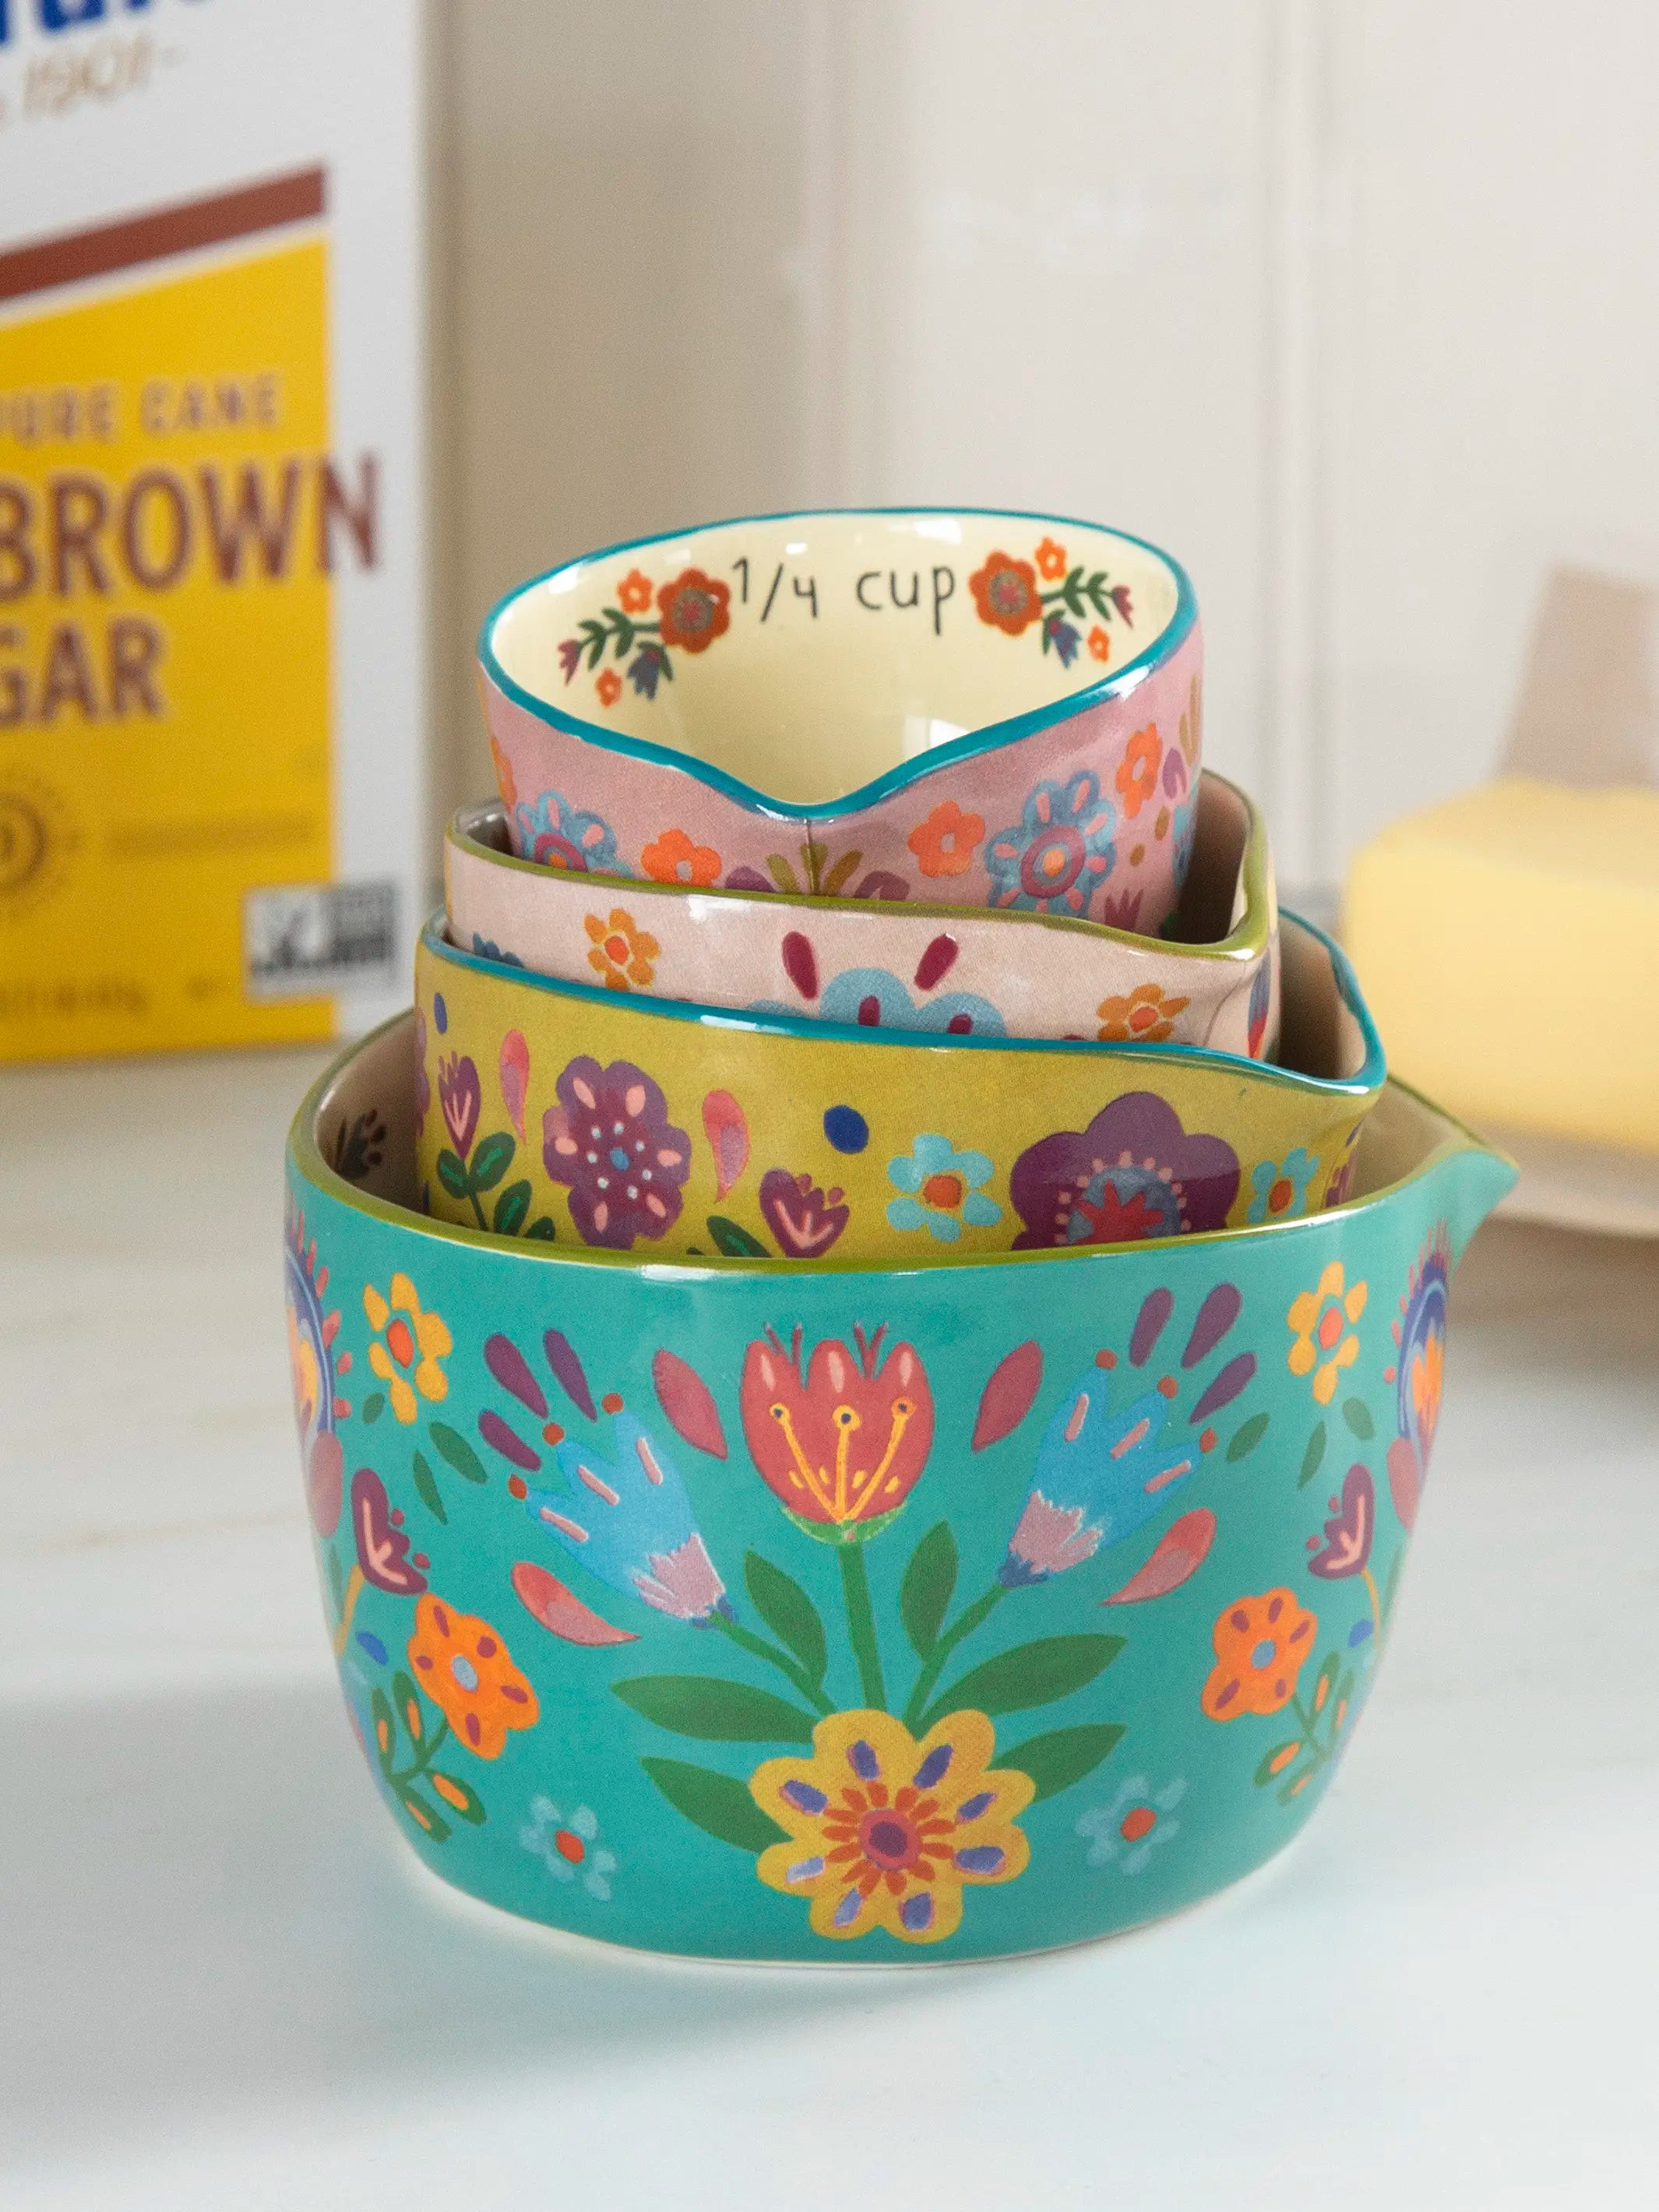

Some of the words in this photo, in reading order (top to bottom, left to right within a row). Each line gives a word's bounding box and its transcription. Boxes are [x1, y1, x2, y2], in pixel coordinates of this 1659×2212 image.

[140, 372, 280, 439] CANE
[0, 450, 382, 602] BROWN
[732, 556, 819, 622] 1/4
[856, 565, 956, 636] cup
